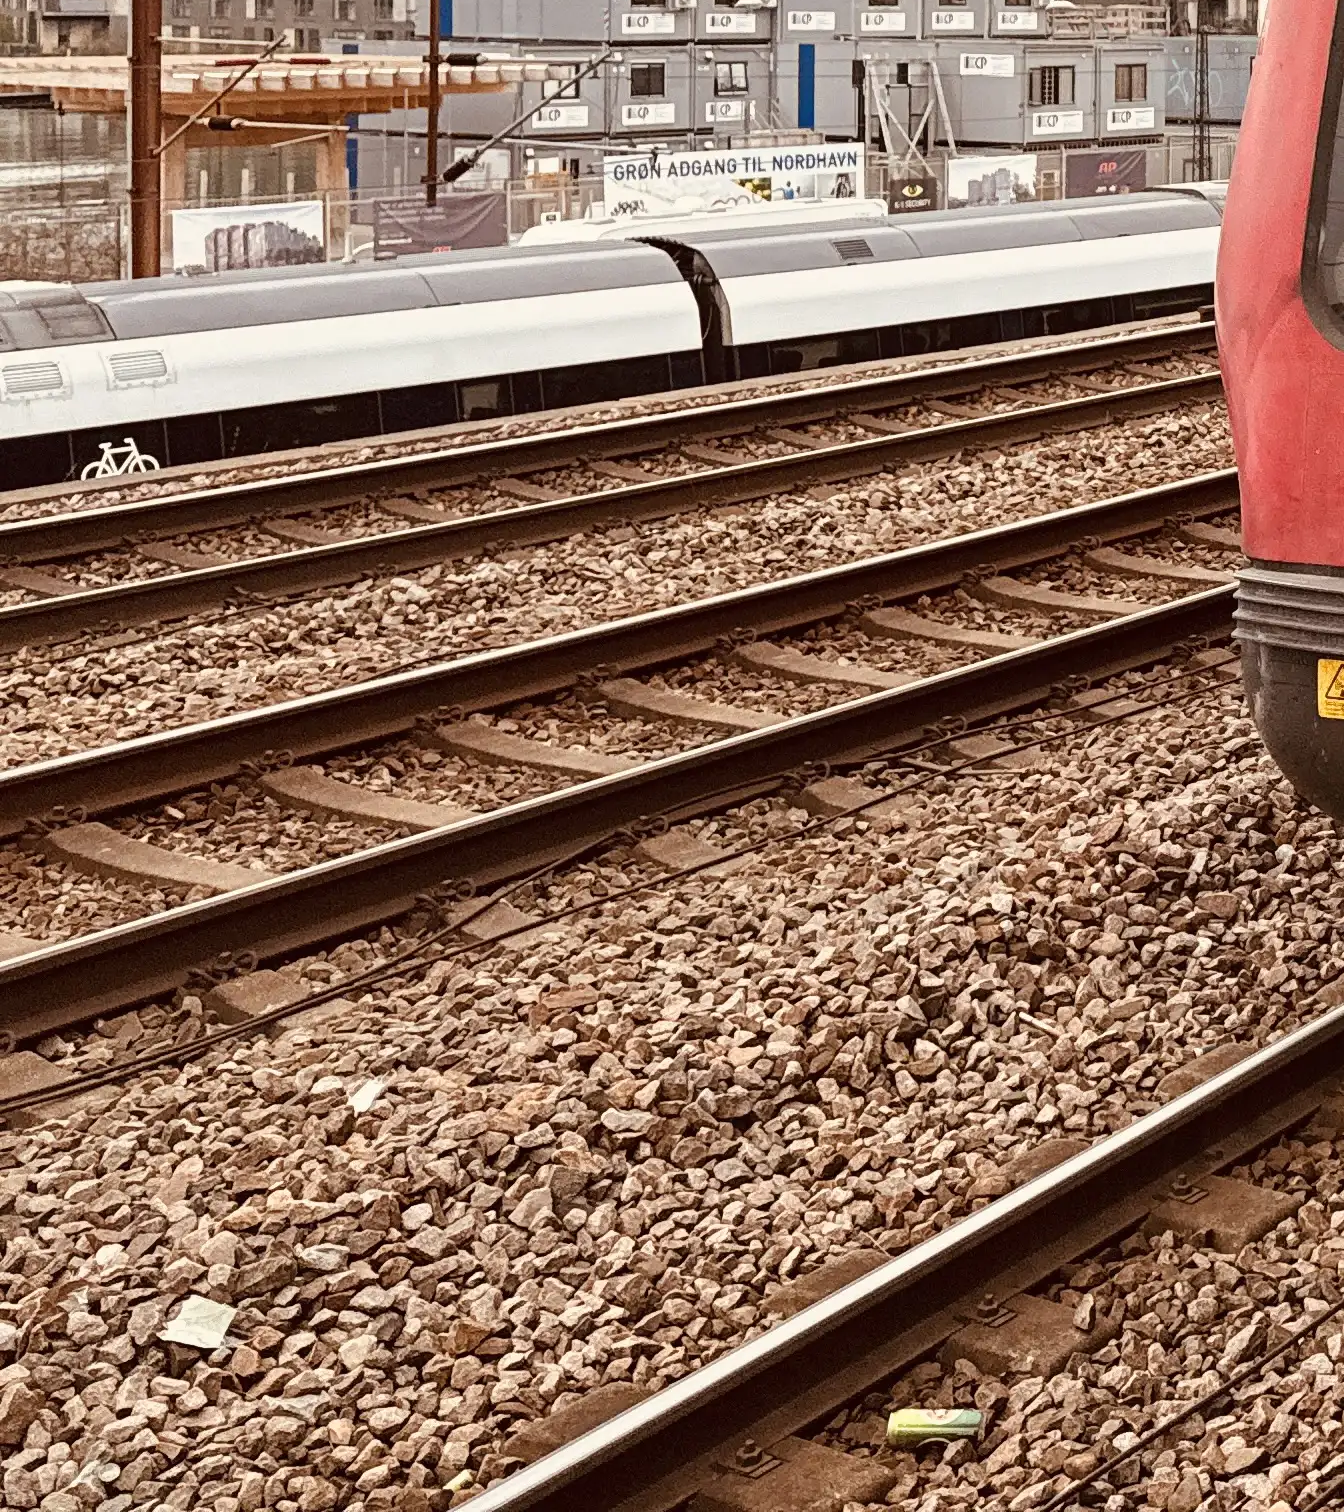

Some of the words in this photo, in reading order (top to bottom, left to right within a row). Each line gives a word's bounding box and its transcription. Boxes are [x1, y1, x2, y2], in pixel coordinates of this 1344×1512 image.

[613, 163, 661, 182] GRØN
[667, 158, 737, 178] ADGANG
[742, 156, 766, 173] TIL
[772, 151, 858, 172] NORDHAVN
